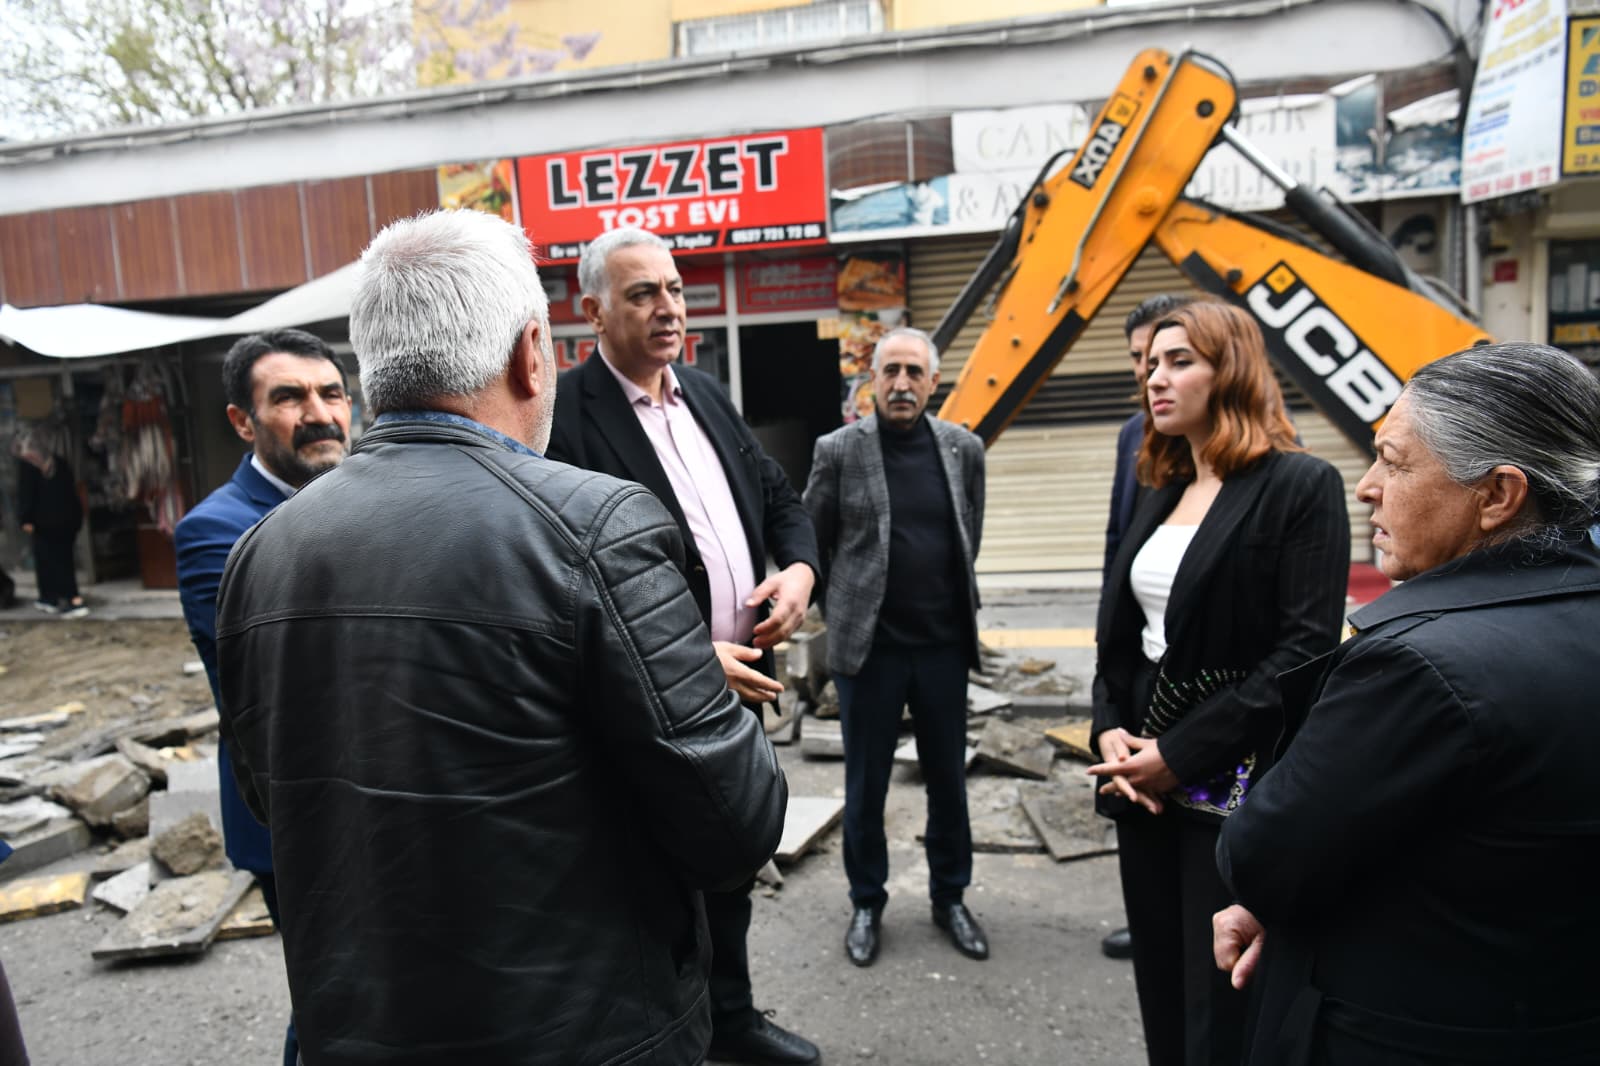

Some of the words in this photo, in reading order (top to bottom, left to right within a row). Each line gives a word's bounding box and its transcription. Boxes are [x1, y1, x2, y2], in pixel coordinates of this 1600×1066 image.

[546, 136, 788, 211] LEZZET
[598, 204, 679, 231] TOST
[1247, 283, 1402, 423] JCB
